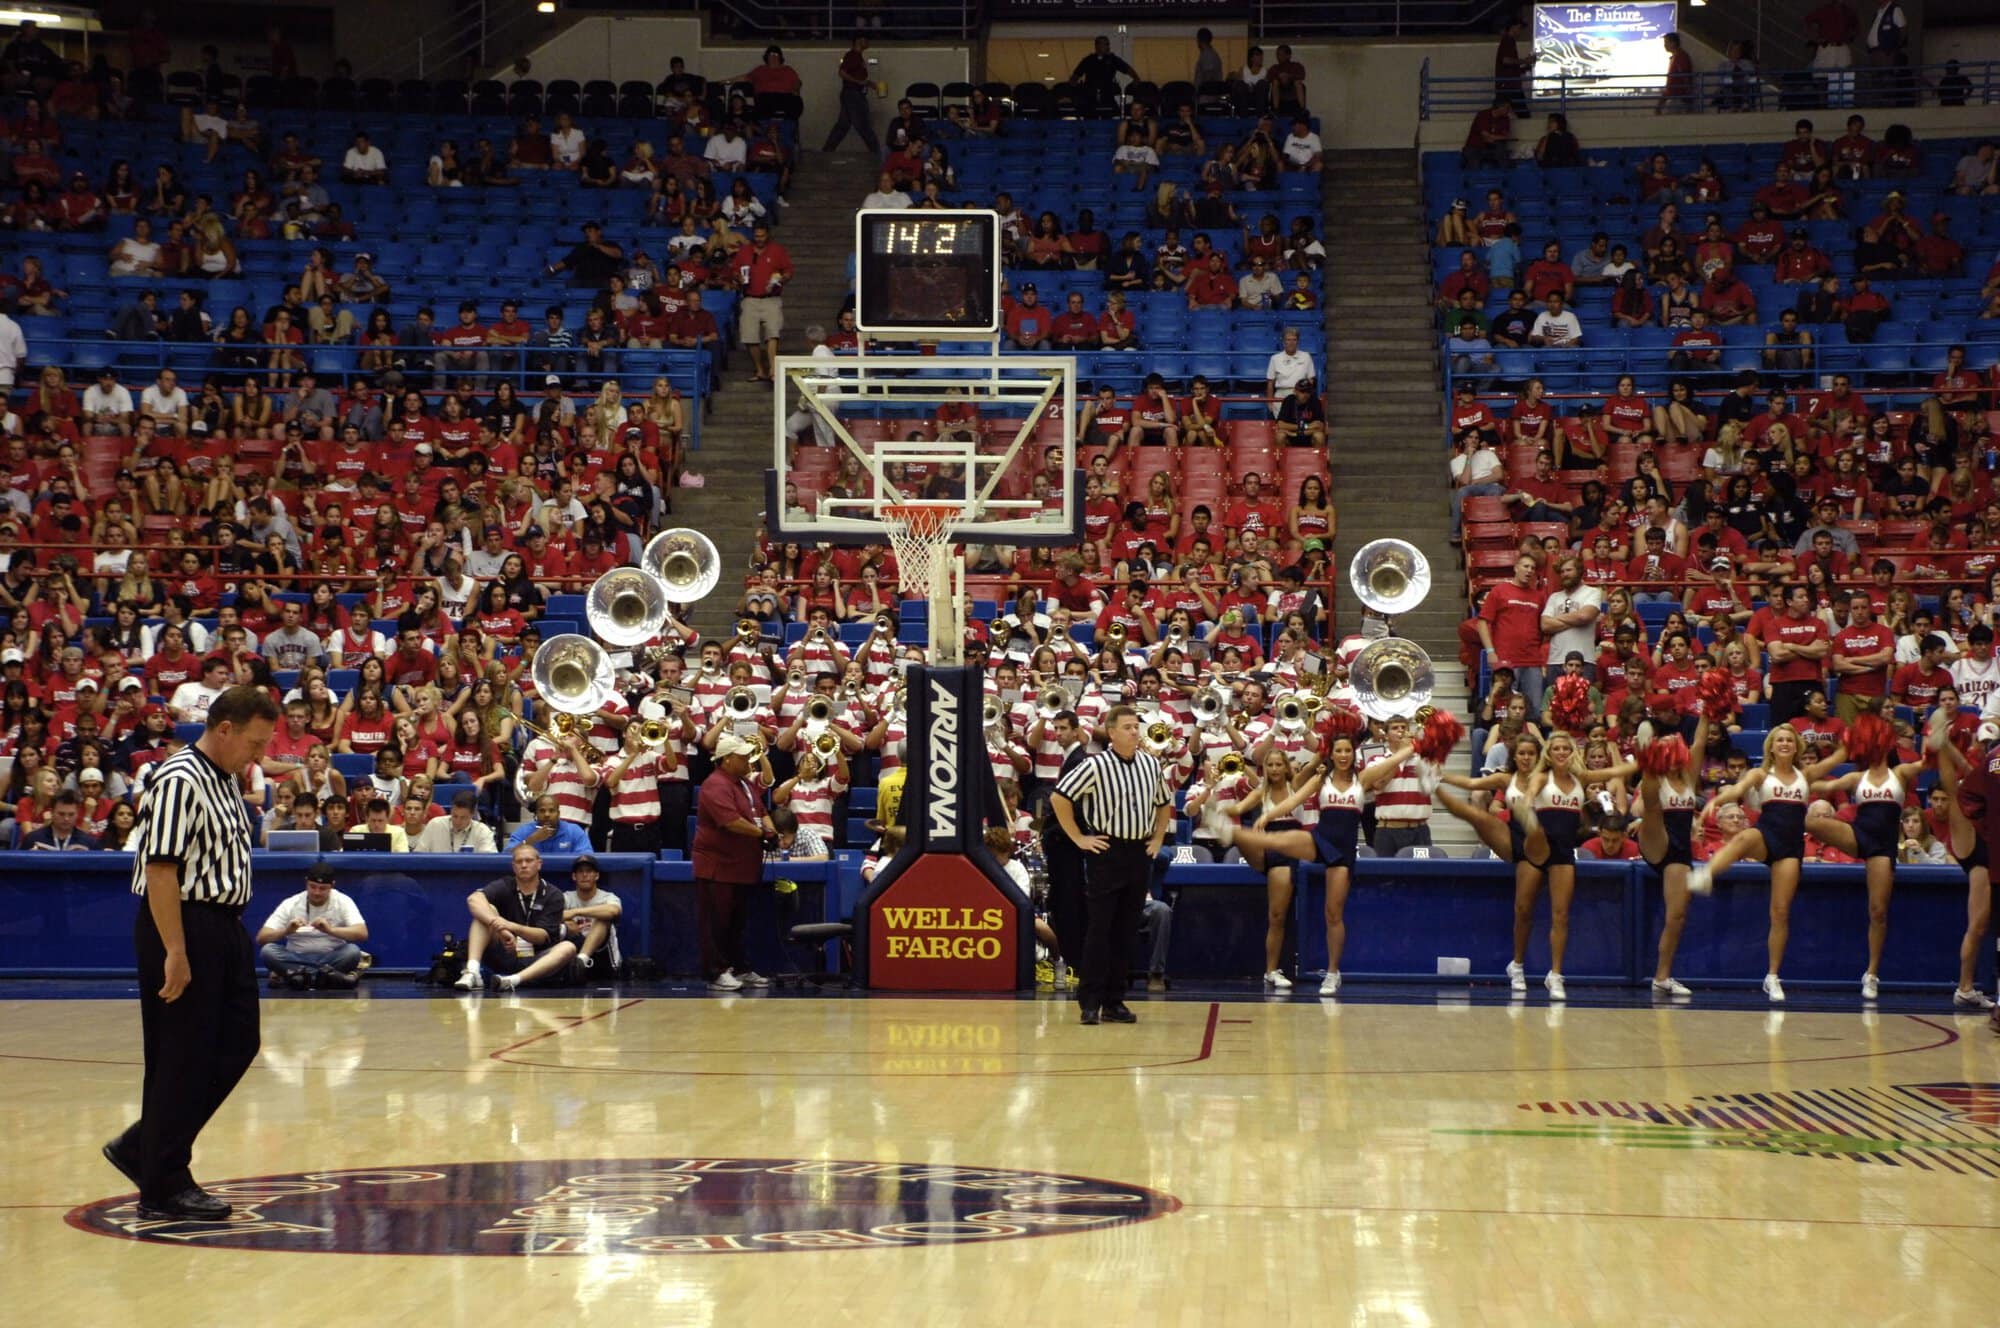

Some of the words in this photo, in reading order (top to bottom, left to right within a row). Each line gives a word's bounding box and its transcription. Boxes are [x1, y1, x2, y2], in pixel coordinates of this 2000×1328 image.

[1566, 8, 1592, 23] The
[887, 223, 956, 254] 14.2
[1972, 692, 1988, 707] 21
[929, 678, 958, 838] ARIZONA
[882, 907, 1004, 931] WELLS
[886, 936, 1002, 960] FARGO
